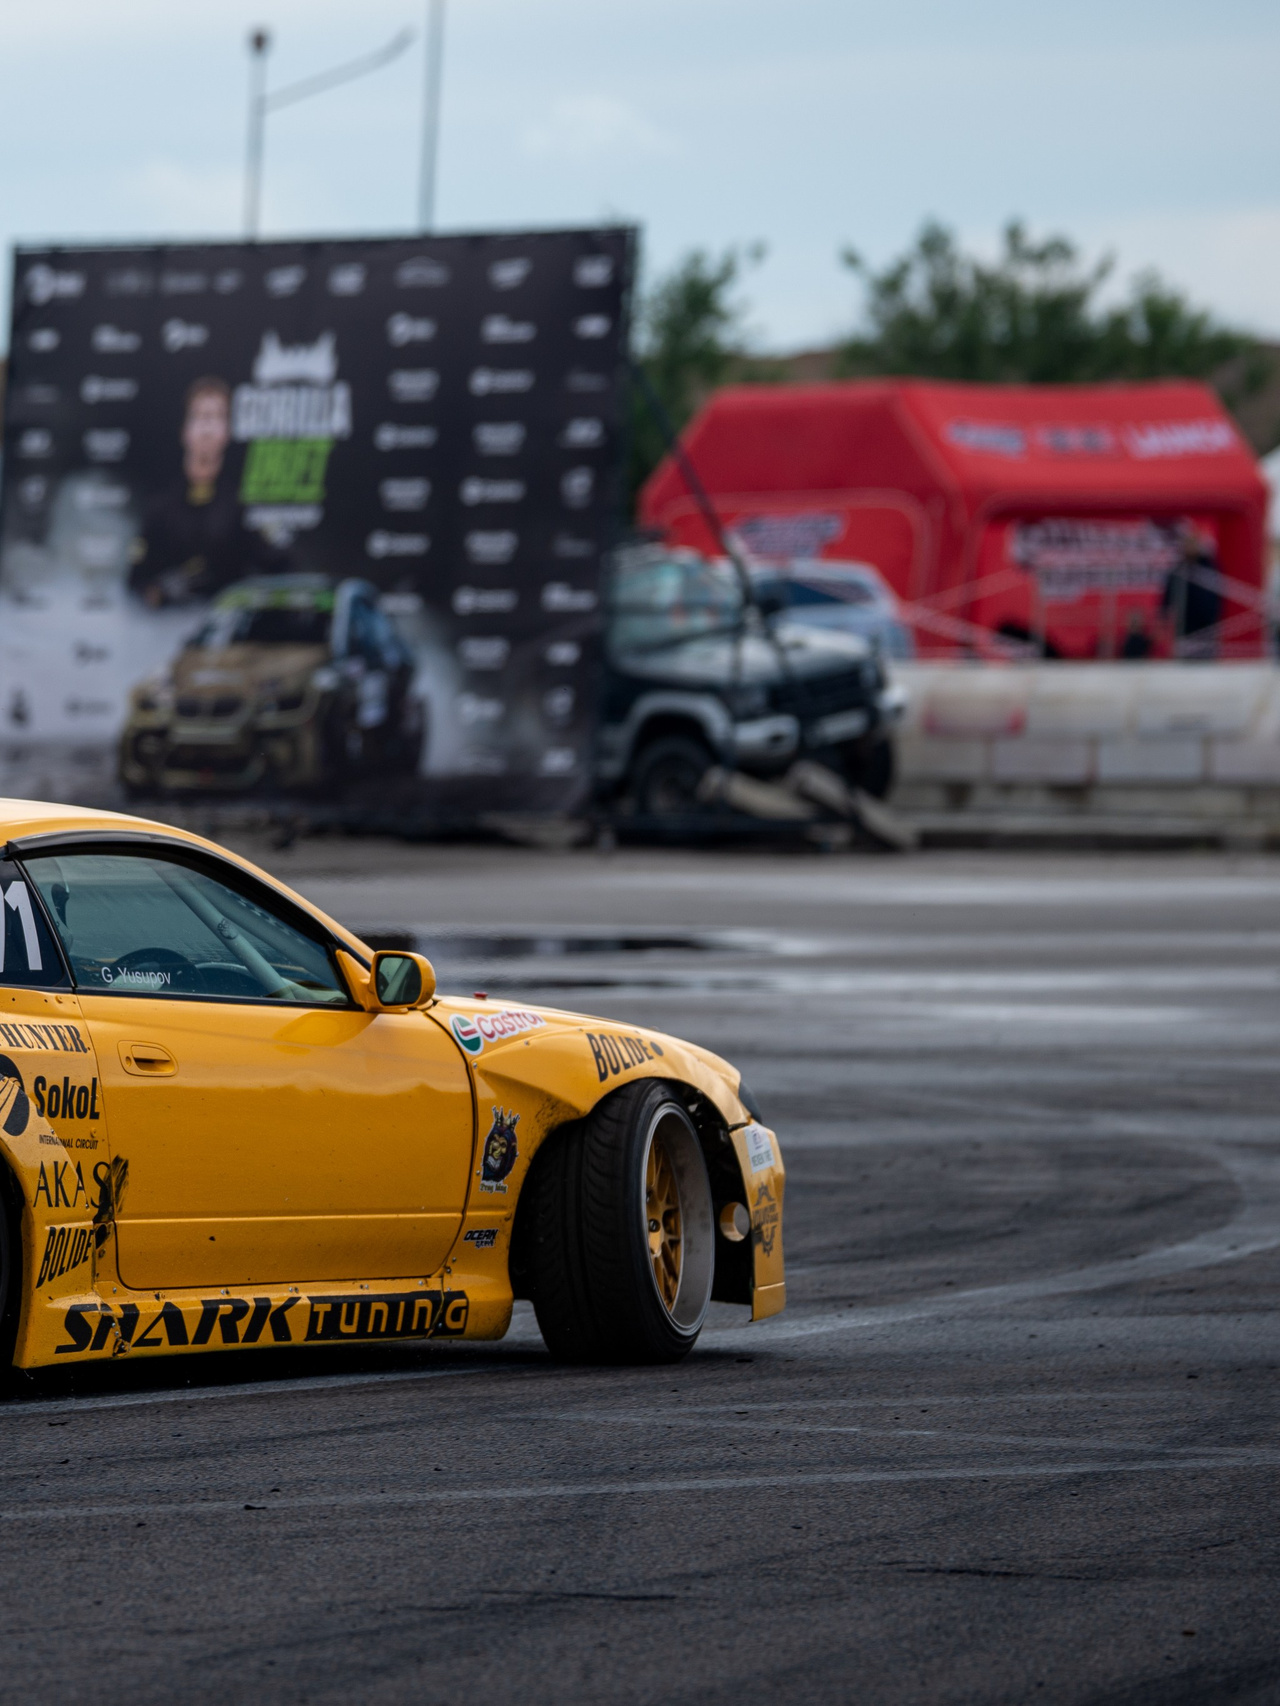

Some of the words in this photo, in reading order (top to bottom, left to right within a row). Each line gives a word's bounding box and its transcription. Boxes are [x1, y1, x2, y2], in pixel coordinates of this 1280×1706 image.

[117, 967, 171, 988] Yusupov
[586, 1032, 655, 1083] BOLIDE
[75, 1138, 98, 1150] CIRCUIT
[33, 1160, 111, 1209] AKAS
[463, 1229, 499, 1241] OCEAN
[36, 1226, 94, 1289] BOLIDE
